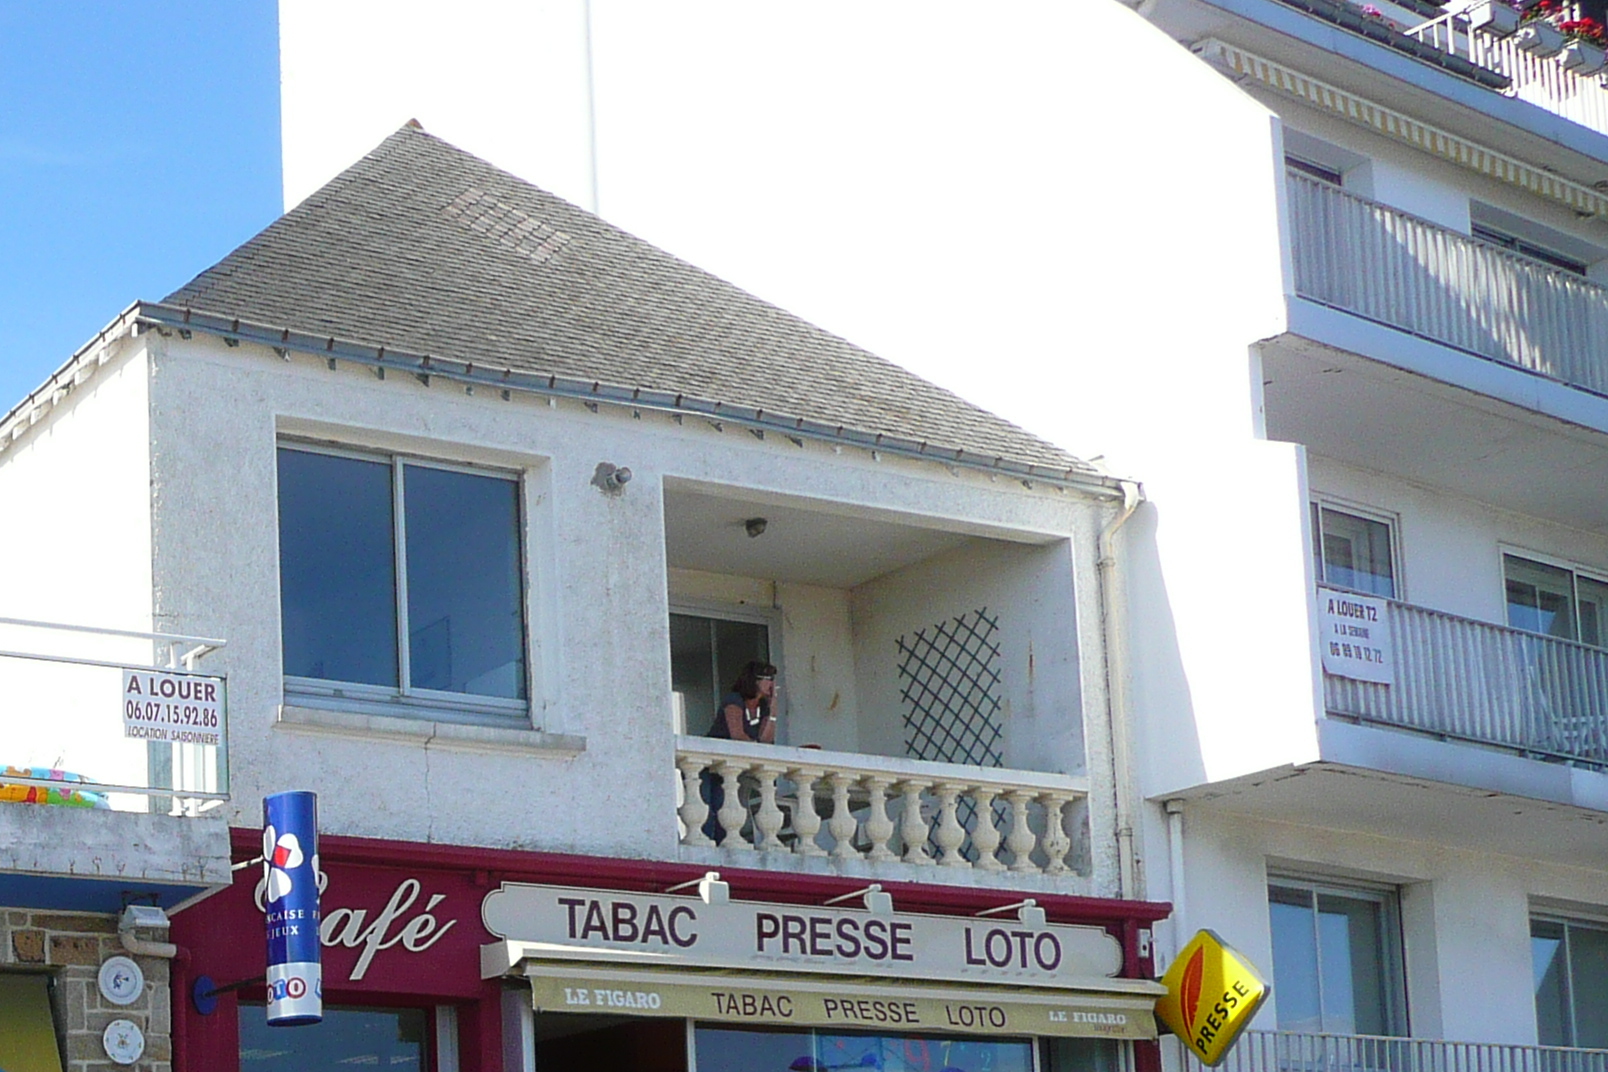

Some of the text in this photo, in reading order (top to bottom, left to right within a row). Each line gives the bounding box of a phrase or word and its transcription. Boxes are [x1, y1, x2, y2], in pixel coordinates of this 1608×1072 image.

[1327, 599, 1378, 622] A LOUER T2
[127, 675, 216, 702] A LOUER
[126, 699, 218, 728] 06.07.15.92.86
[127, 725, 168, 740] LOCATION
[557, 897, 1062, 971] TABAC PRESSE LOTO
[564, 987, 662, 1009] LE FIGARO
[710, 992, 1007, 1028] TABAC PRESSE LOTO
[1048, 1010, 1127, 1025] LE FIGARO
[1196, 979, 1250, 1056] PRESSE
